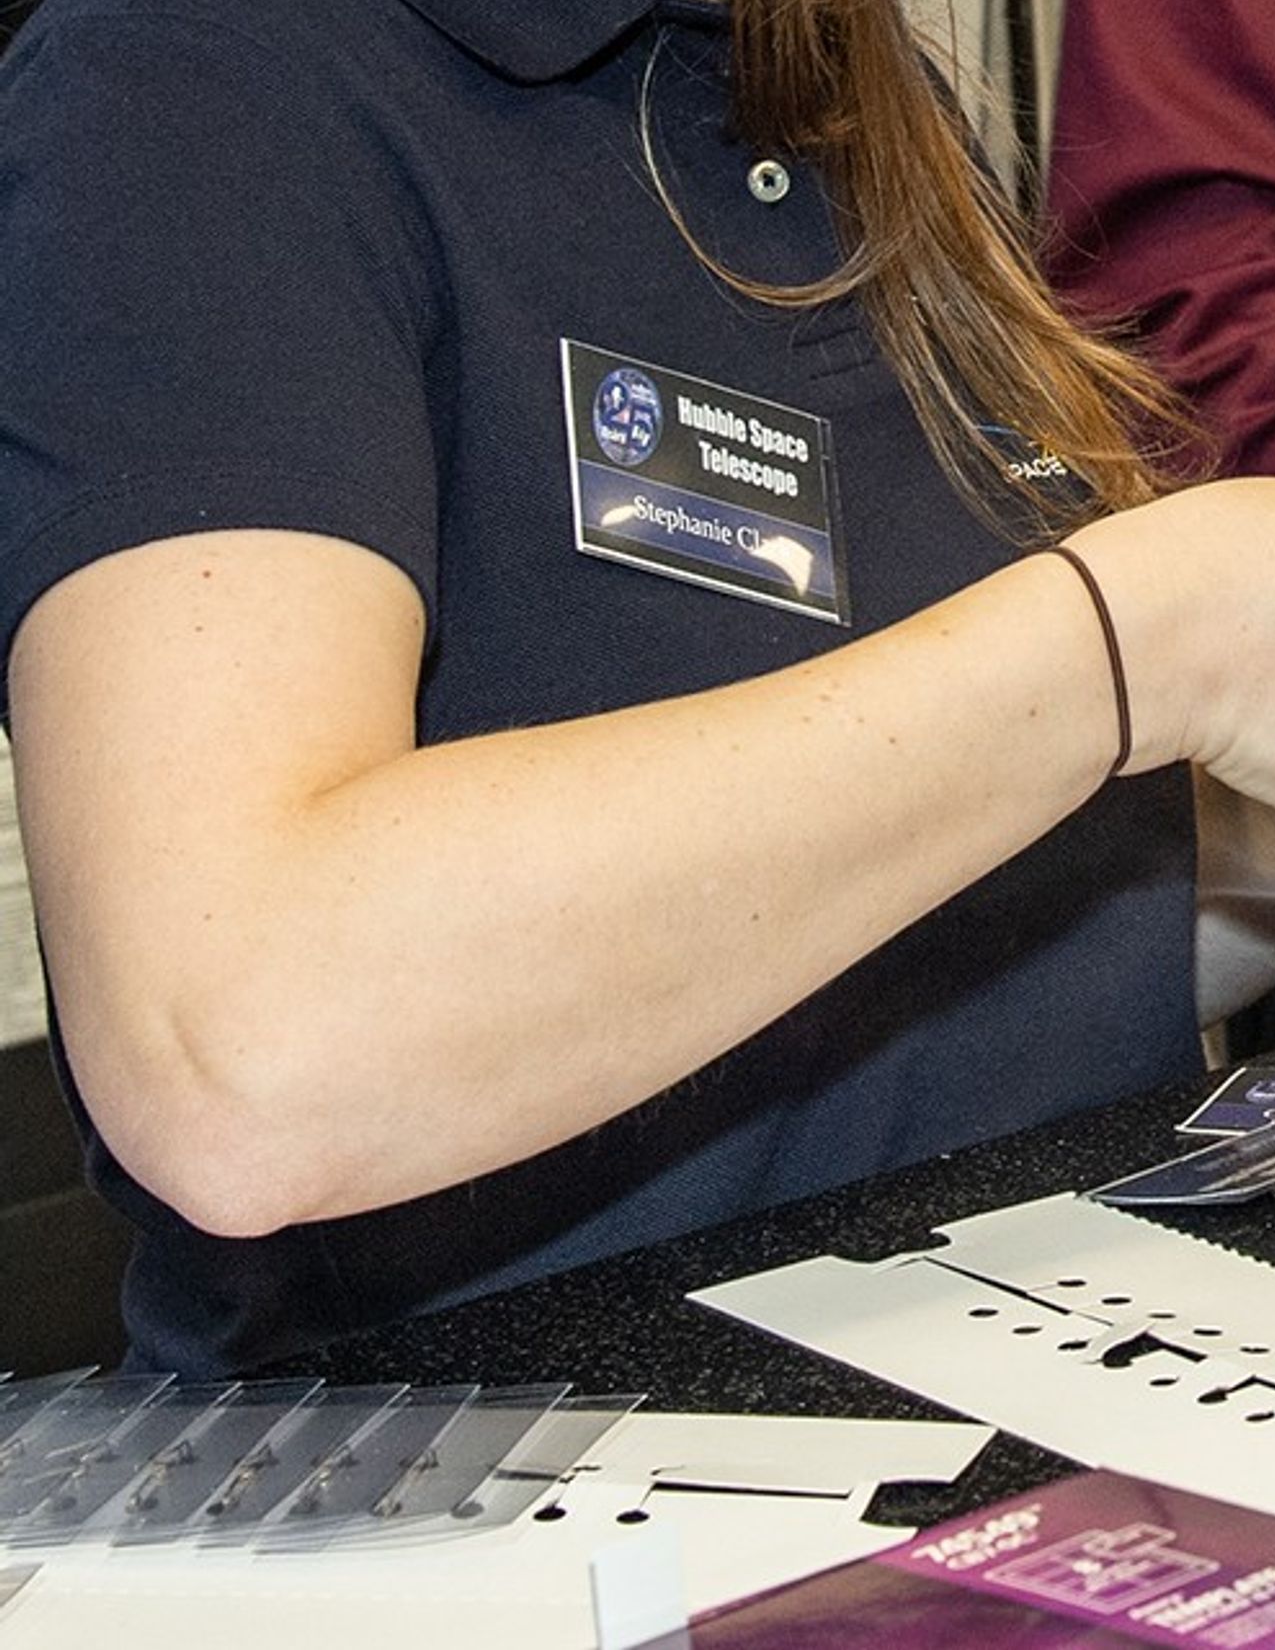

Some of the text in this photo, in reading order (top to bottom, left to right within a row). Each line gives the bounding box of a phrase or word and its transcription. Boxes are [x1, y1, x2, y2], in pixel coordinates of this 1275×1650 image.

[677, 395, 746, 443] Hubble
[748, 418, 809, 463] Space
[698, 440, 798, 497] Telescope
[633, 494, 732, 546] Stephanie
